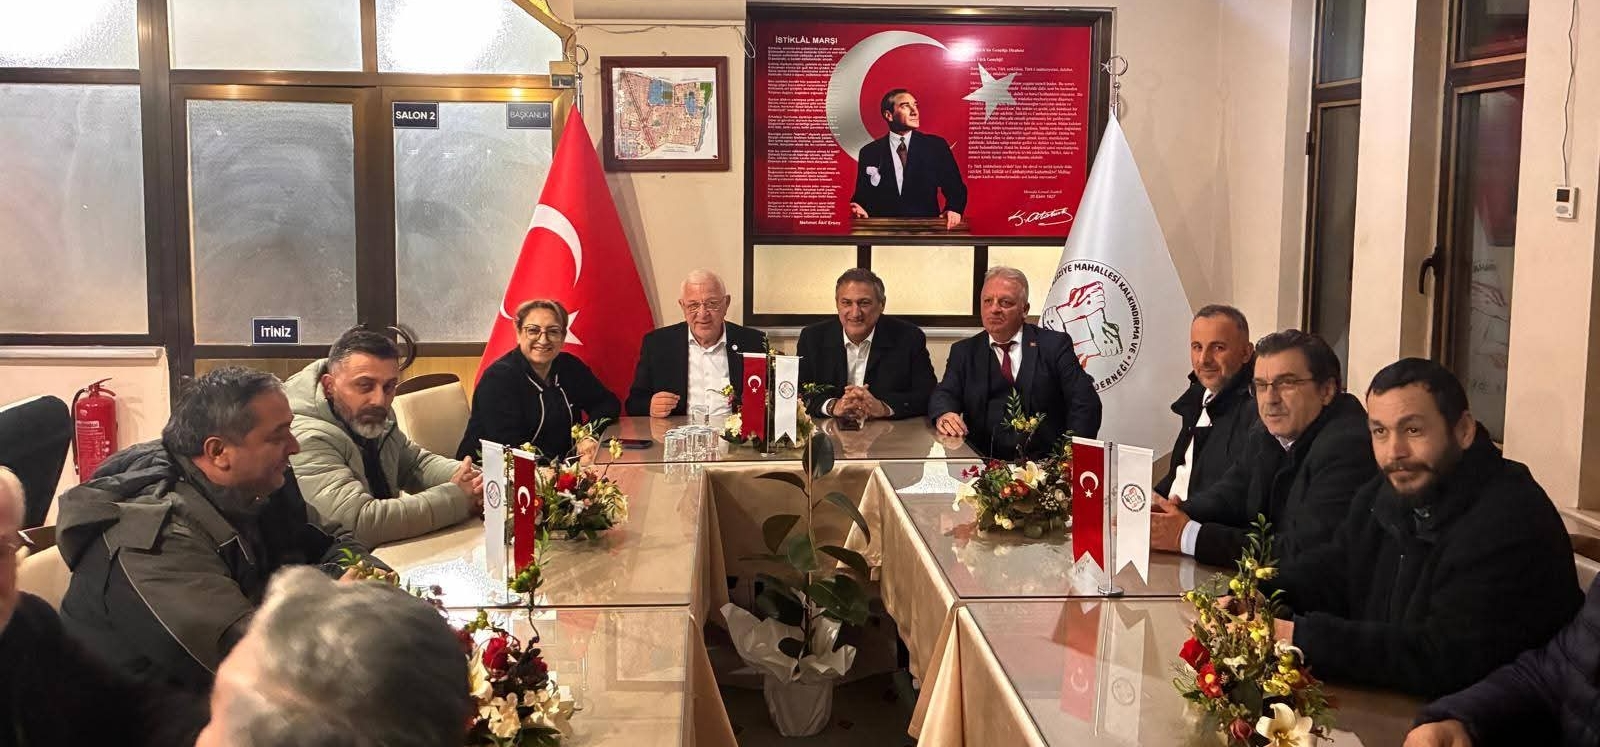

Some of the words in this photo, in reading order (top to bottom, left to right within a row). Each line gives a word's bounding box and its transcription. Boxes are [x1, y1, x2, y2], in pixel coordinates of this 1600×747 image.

[775, 35, 811, 44] İSTİKLÂL
[812, 37, 838, 45] MARŞI
[395, 111, 428, 120] SALON
[430, 111, 436, 120] 2
[509, 111, 550, 120] BAŞKANLIK
[1074, 263, 1121, 284] MAHALLESİ
[1118, 281, 1140, 340] KALKINDIRMA
[1129, 342, 1138, 354] VE
[260, 325, 292, 338] İTİNİZ
